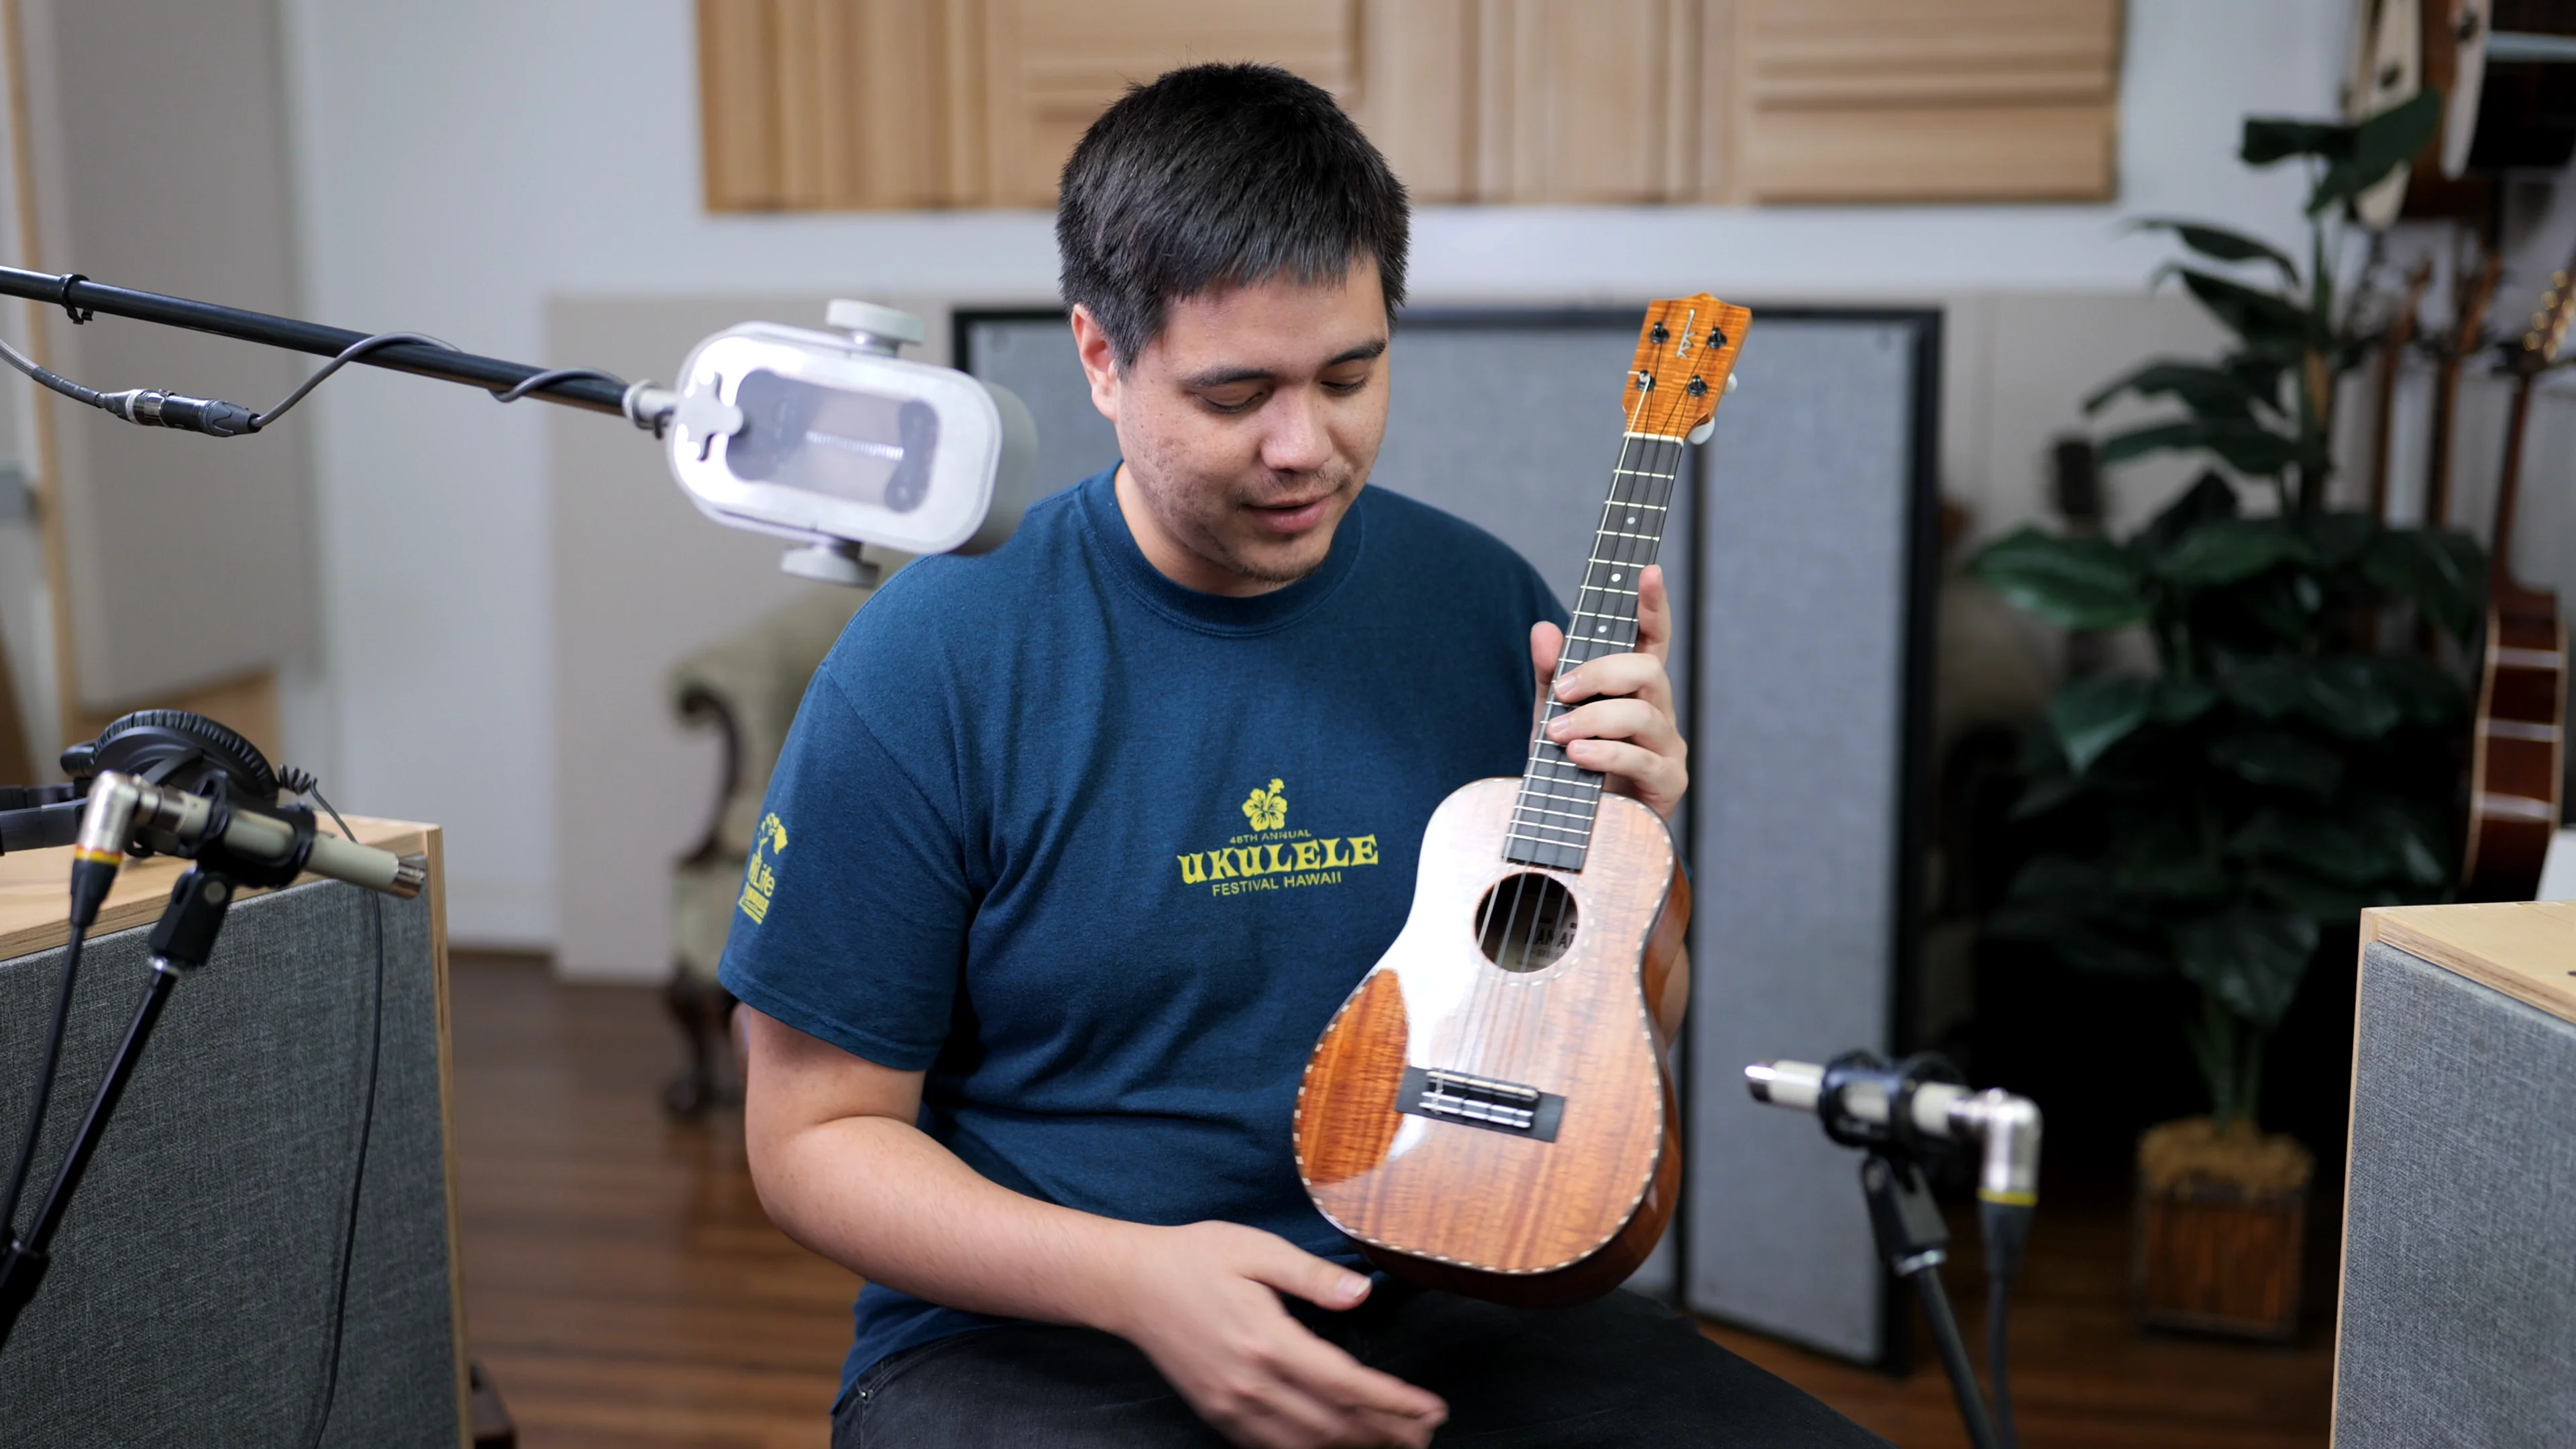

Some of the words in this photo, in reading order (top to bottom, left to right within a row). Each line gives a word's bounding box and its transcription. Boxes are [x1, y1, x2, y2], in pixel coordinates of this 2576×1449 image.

[1229, 834, 1258, 844] 48TH
[1261, 829, 1312, 841] ANNUAL
[1176, 834, 1379, 885] UKULELE
[1212, 877, 1279, 897] FESTIVAL
[1283, 871, 1342, 889] HAWAII
